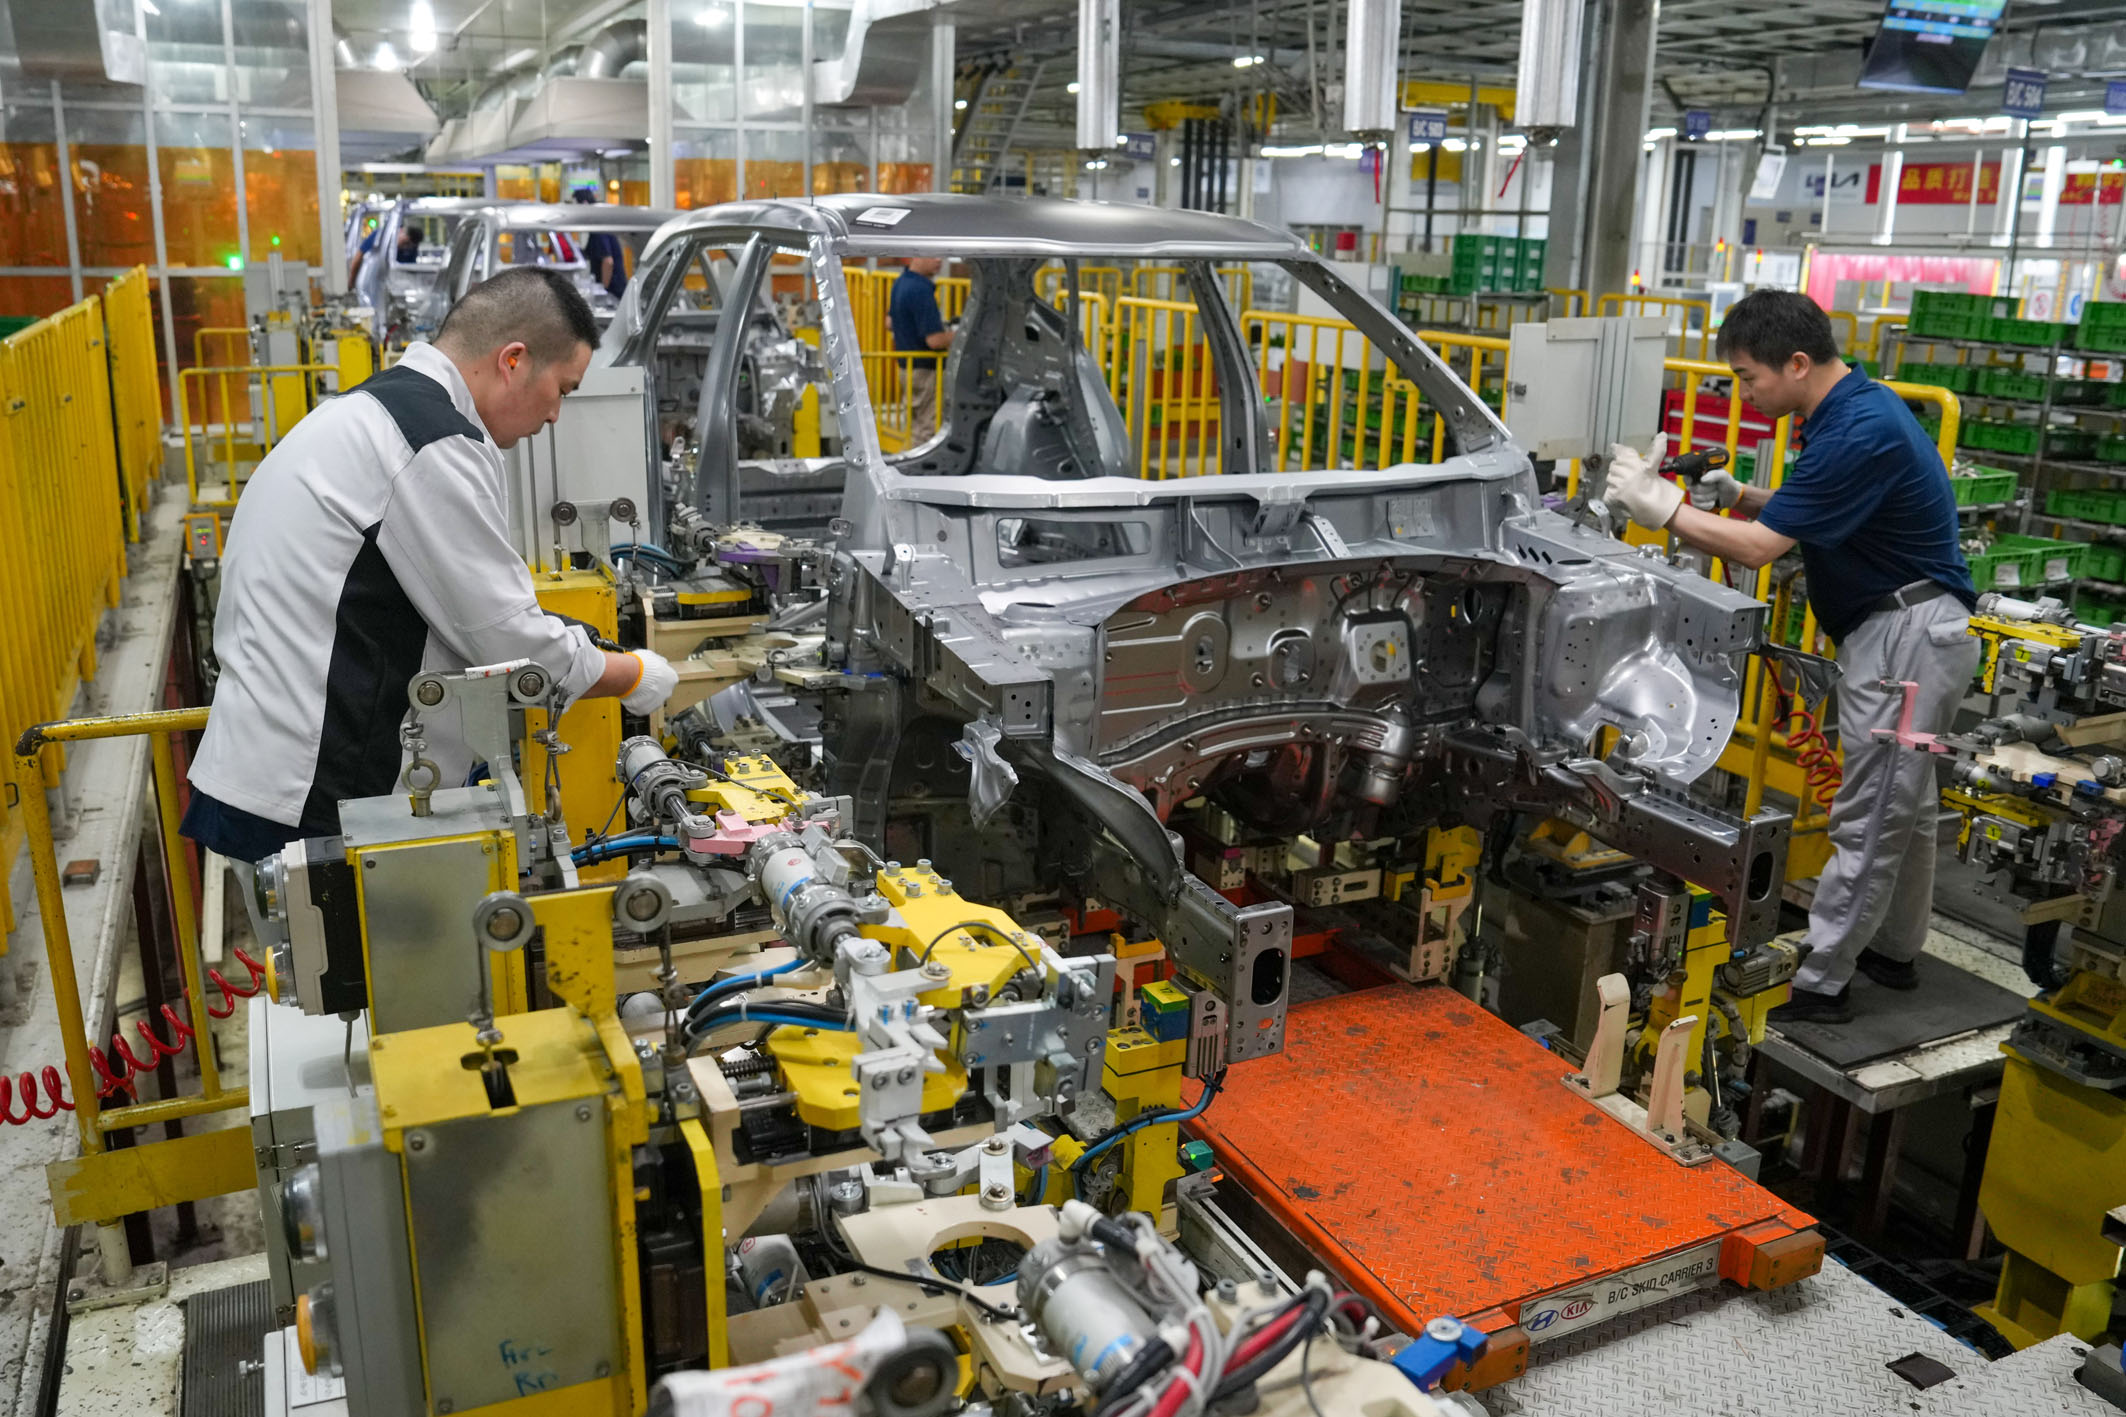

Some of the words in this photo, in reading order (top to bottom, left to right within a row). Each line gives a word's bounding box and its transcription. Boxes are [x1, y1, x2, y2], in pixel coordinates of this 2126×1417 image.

[1608, 1287, 1628, 1304] B/C
[1632, 1278, 1657, 1296] SKID
[1660, 1261, 1703, 1287] CARRIER
[1706, 1257, 1714, 1271] 3
